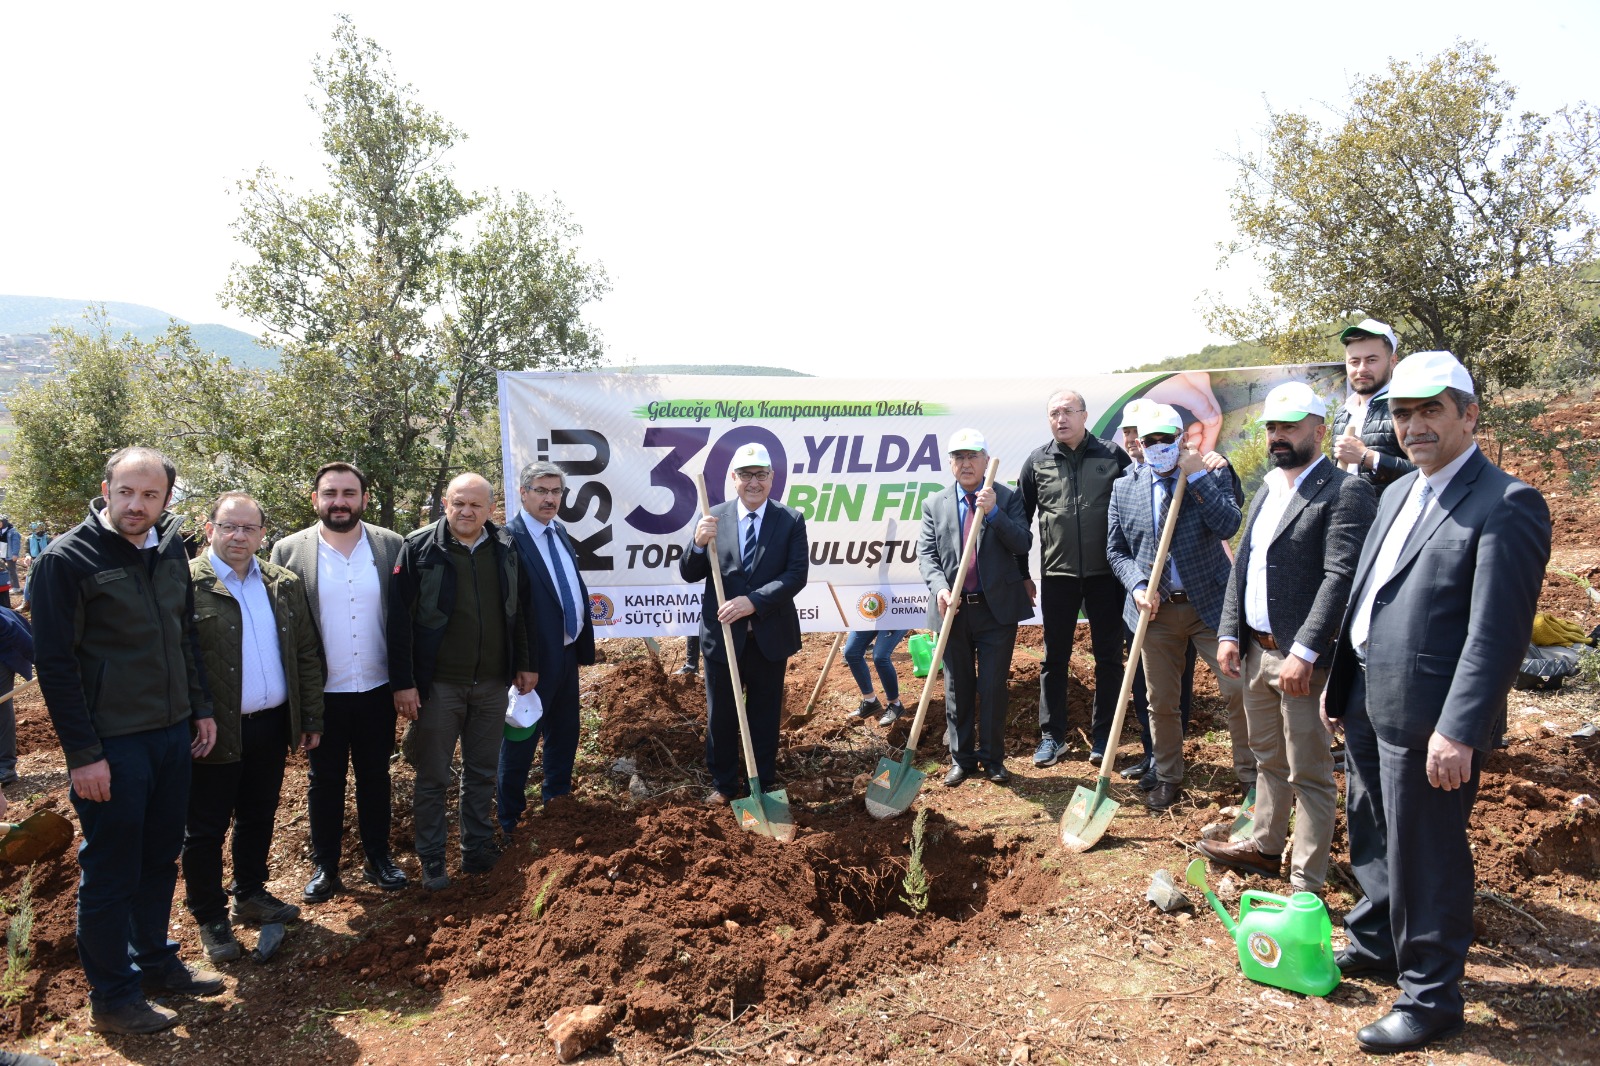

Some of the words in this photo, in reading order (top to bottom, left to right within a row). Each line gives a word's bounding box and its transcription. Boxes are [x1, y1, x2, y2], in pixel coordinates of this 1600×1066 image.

[648, 401, 711, 422] Geleceğe
[715, 400, 754, 422] Nefes
[758, 401, 872, 421] Kampanyasına
[876, 400, 923, 416] Destek
[537, 429, 614, 571] KSÜ
[626, 544, 683, 569] TOP
[810, 540, 918, 568] ULUŞTU
[891, 595, 929, 604] KAHRAM
[625, 609, 672, 627] SÜTÇÜ
[796, 605, 819, 620] ESİ
[891, 607, 927, 615] ORMAN
